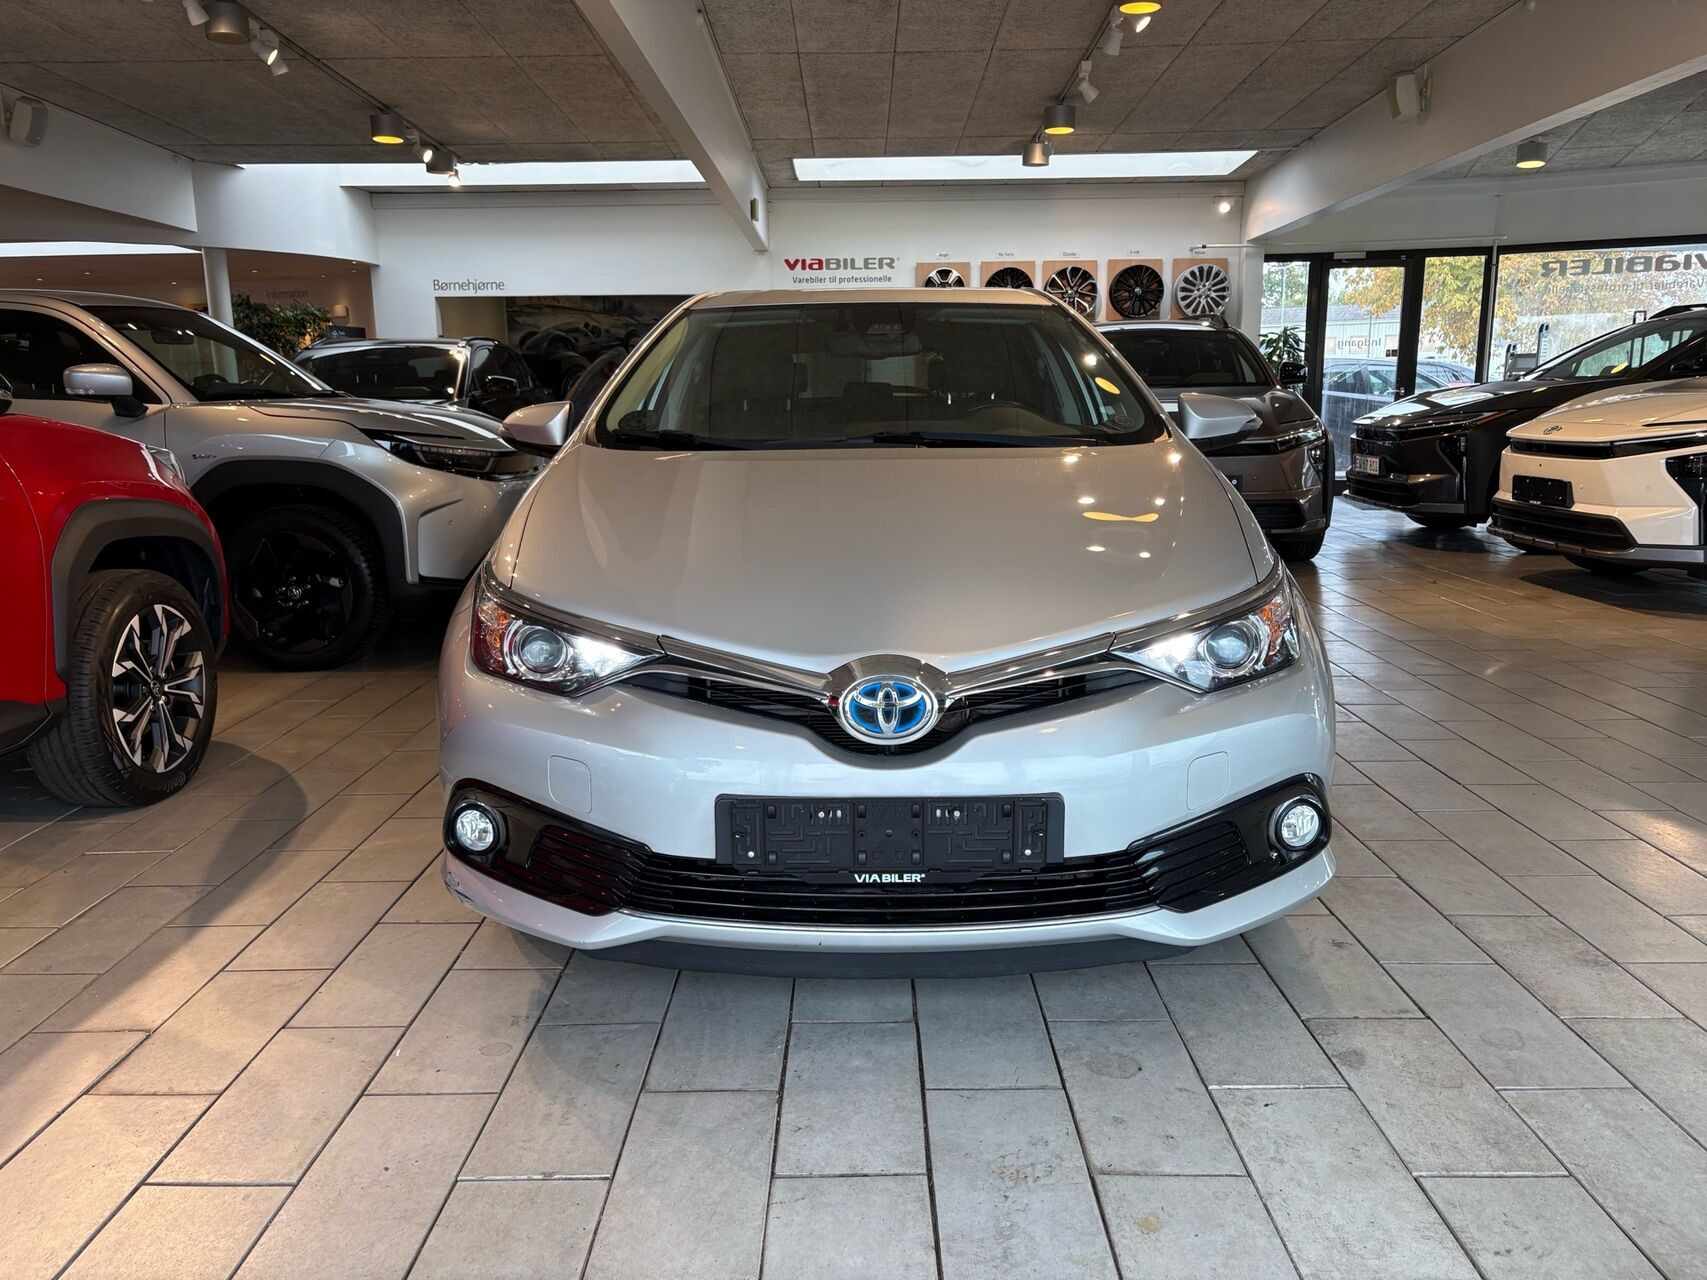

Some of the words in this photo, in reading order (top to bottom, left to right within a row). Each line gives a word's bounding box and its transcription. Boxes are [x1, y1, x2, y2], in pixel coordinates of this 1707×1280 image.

[792, 276, 827, 284] Varebiler
[829, 275, 837, 283] til
[838, 275, 893, 284] professionelle
[433, 279, 505, 294] Børnehjørne
